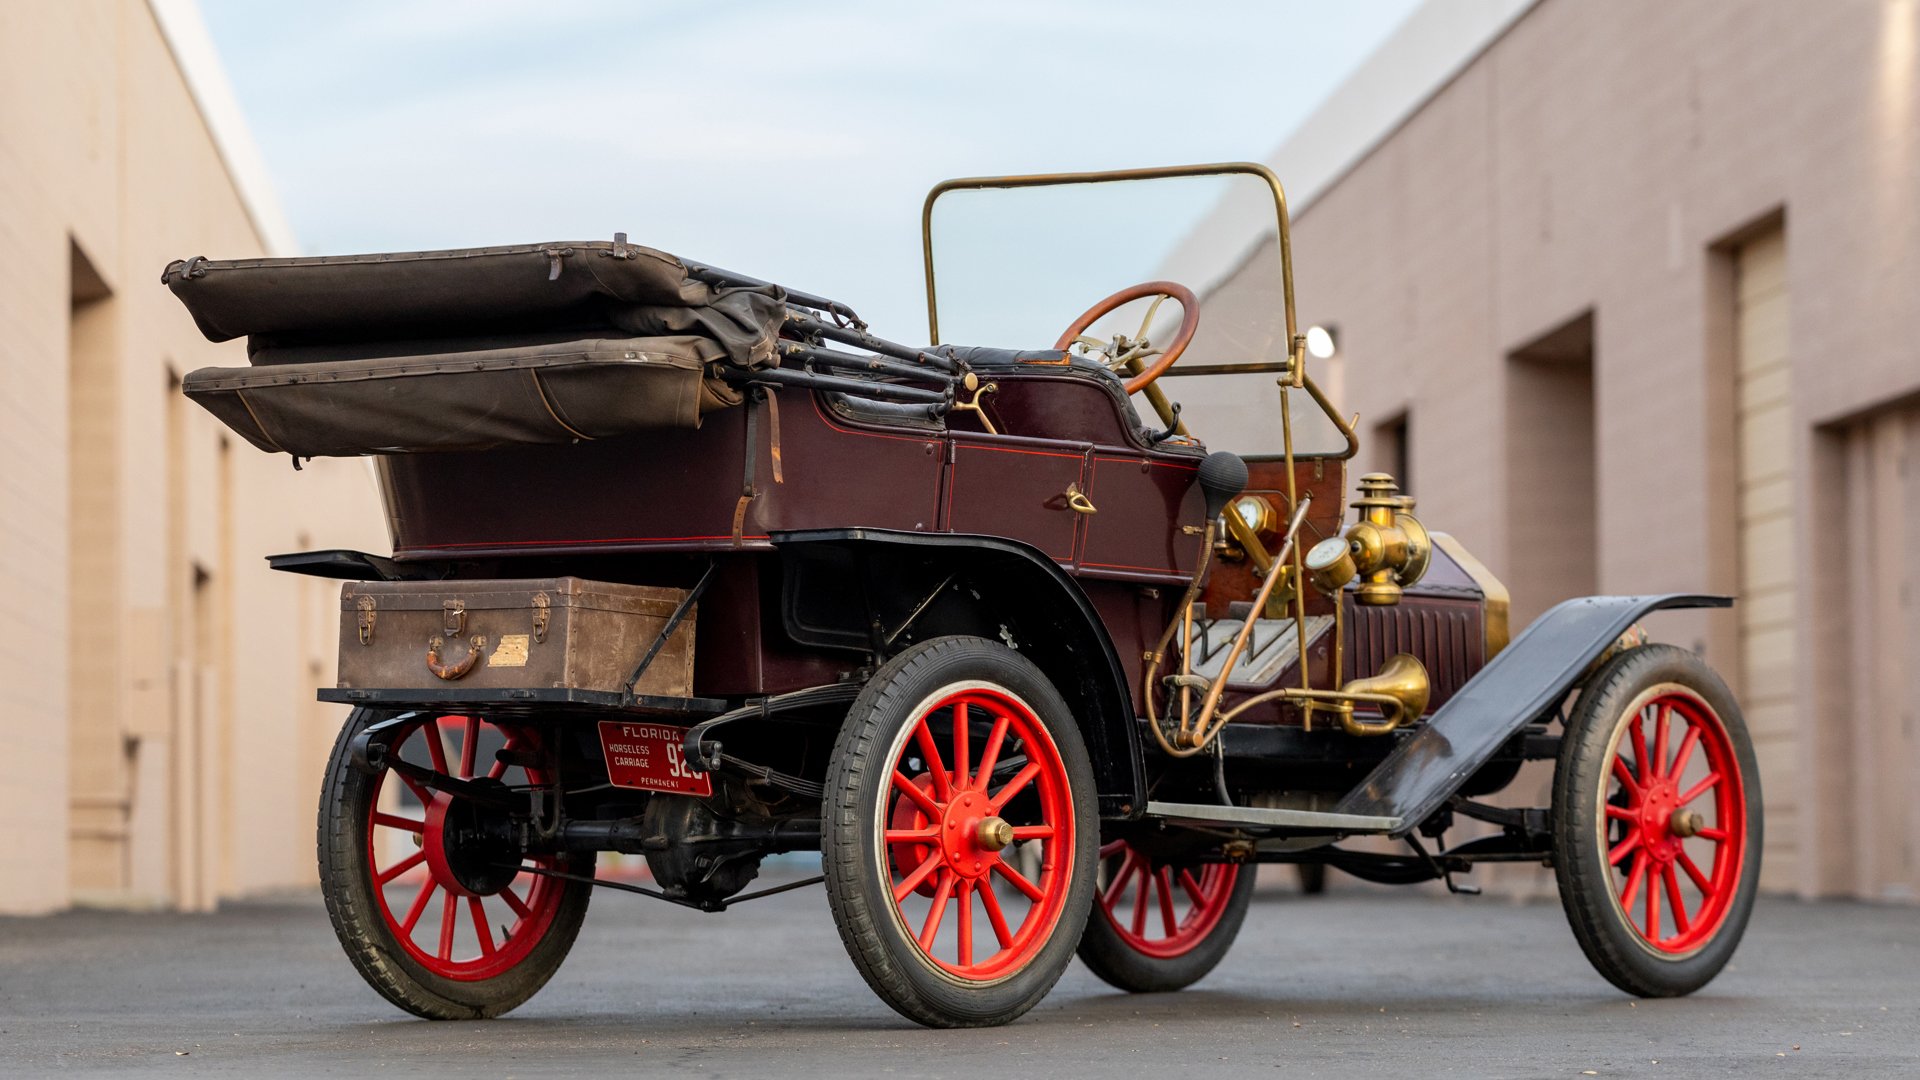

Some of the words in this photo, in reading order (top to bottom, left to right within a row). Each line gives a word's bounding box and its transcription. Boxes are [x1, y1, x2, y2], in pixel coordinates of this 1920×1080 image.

[623, 727, 680, 741] FLORIDA
[609, 744, 650, 755] HORSELESS
[615, 757, 650, 768] CARRIAGE
[666, 743, 703, 780] 92
[641, 777, 679, 788] PERMANENT
